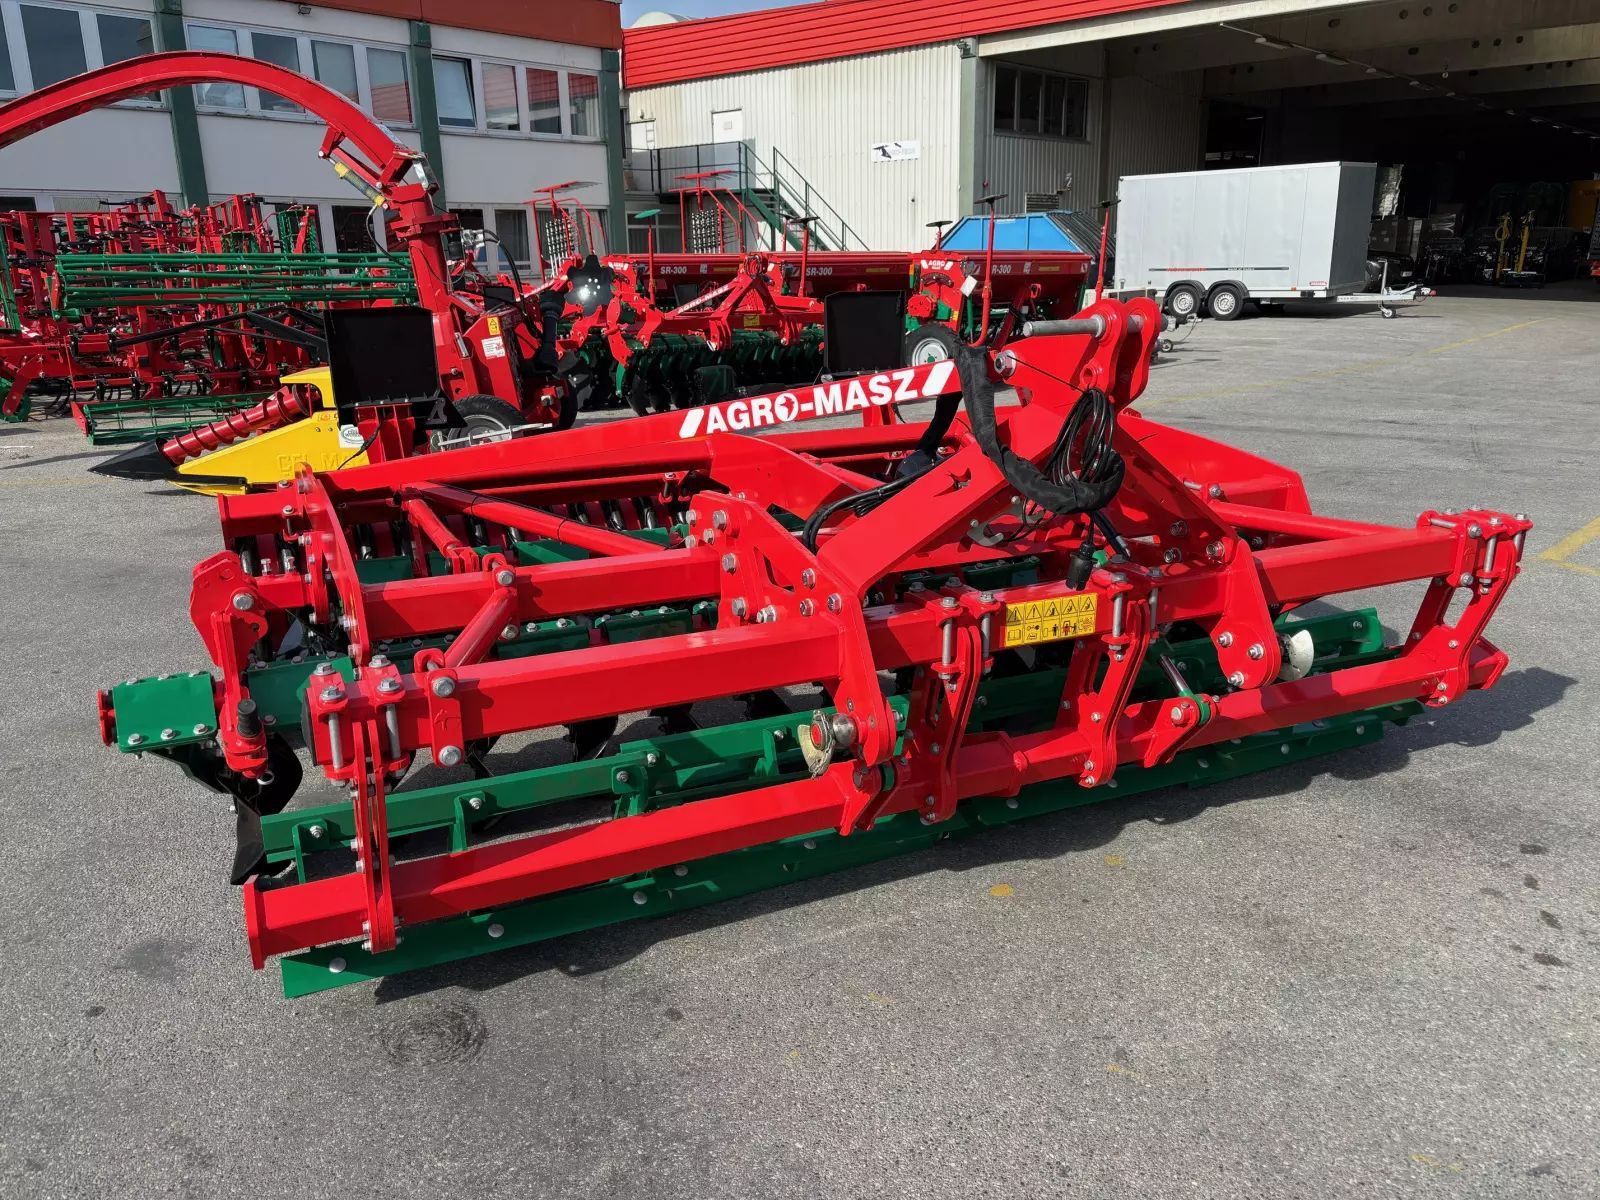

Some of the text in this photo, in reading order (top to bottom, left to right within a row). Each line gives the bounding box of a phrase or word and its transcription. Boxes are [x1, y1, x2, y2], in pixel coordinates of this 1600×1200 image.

[660, 266, 687, 274] SR-300
[806, 267, 833, 276] SR-300
[991, 264, 1012, 274] R-300
[706, 369, 918, 434] AGRO-MASZ
